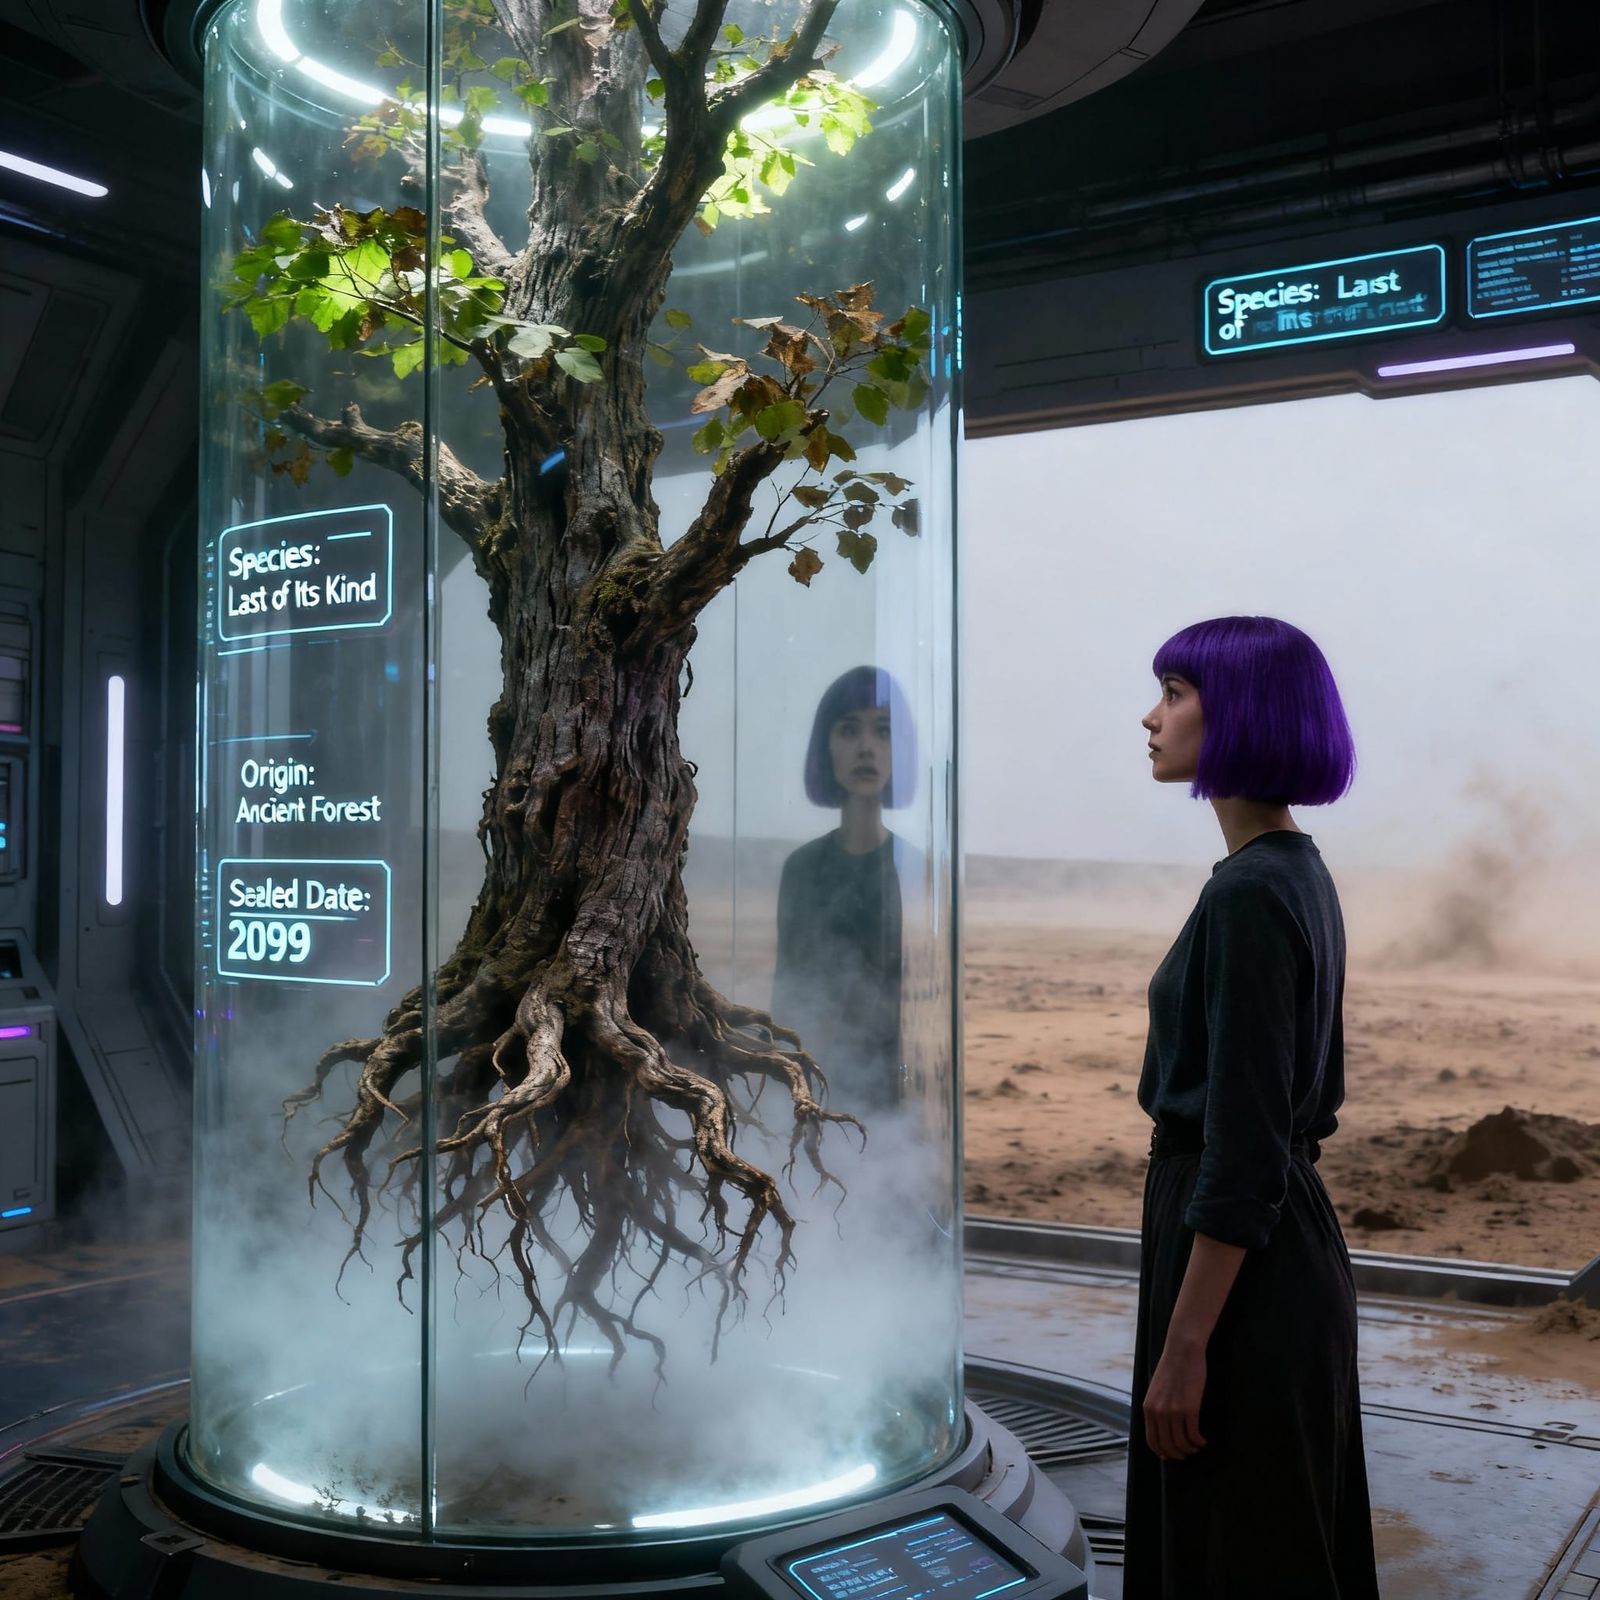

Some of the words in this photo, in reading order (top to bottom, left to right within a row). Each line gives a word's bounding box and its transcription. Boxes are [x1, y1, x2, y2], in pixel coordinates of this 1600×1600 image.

[1218, 281, 1320, 320] Species:
[1337, 269, 1402, 299] Last
[1218, 319, 1243, 340] of
[228, 540, 321, 580] Species:
[228, 585, 268, 616] Last
[271, 579, 292, 611] of
[294, 580, 321, 608] Its
[325, 571, 377, 605] Kind
[240, 757, 315, 794] Origin:
[235, 796, 306, 824] Ancient
[310, 795, 382, 823] Forest
[228, 877, 299, 909] Sealed
[306, 880, 371, 912] Date:
[227, 919, 312, 963] 2099
